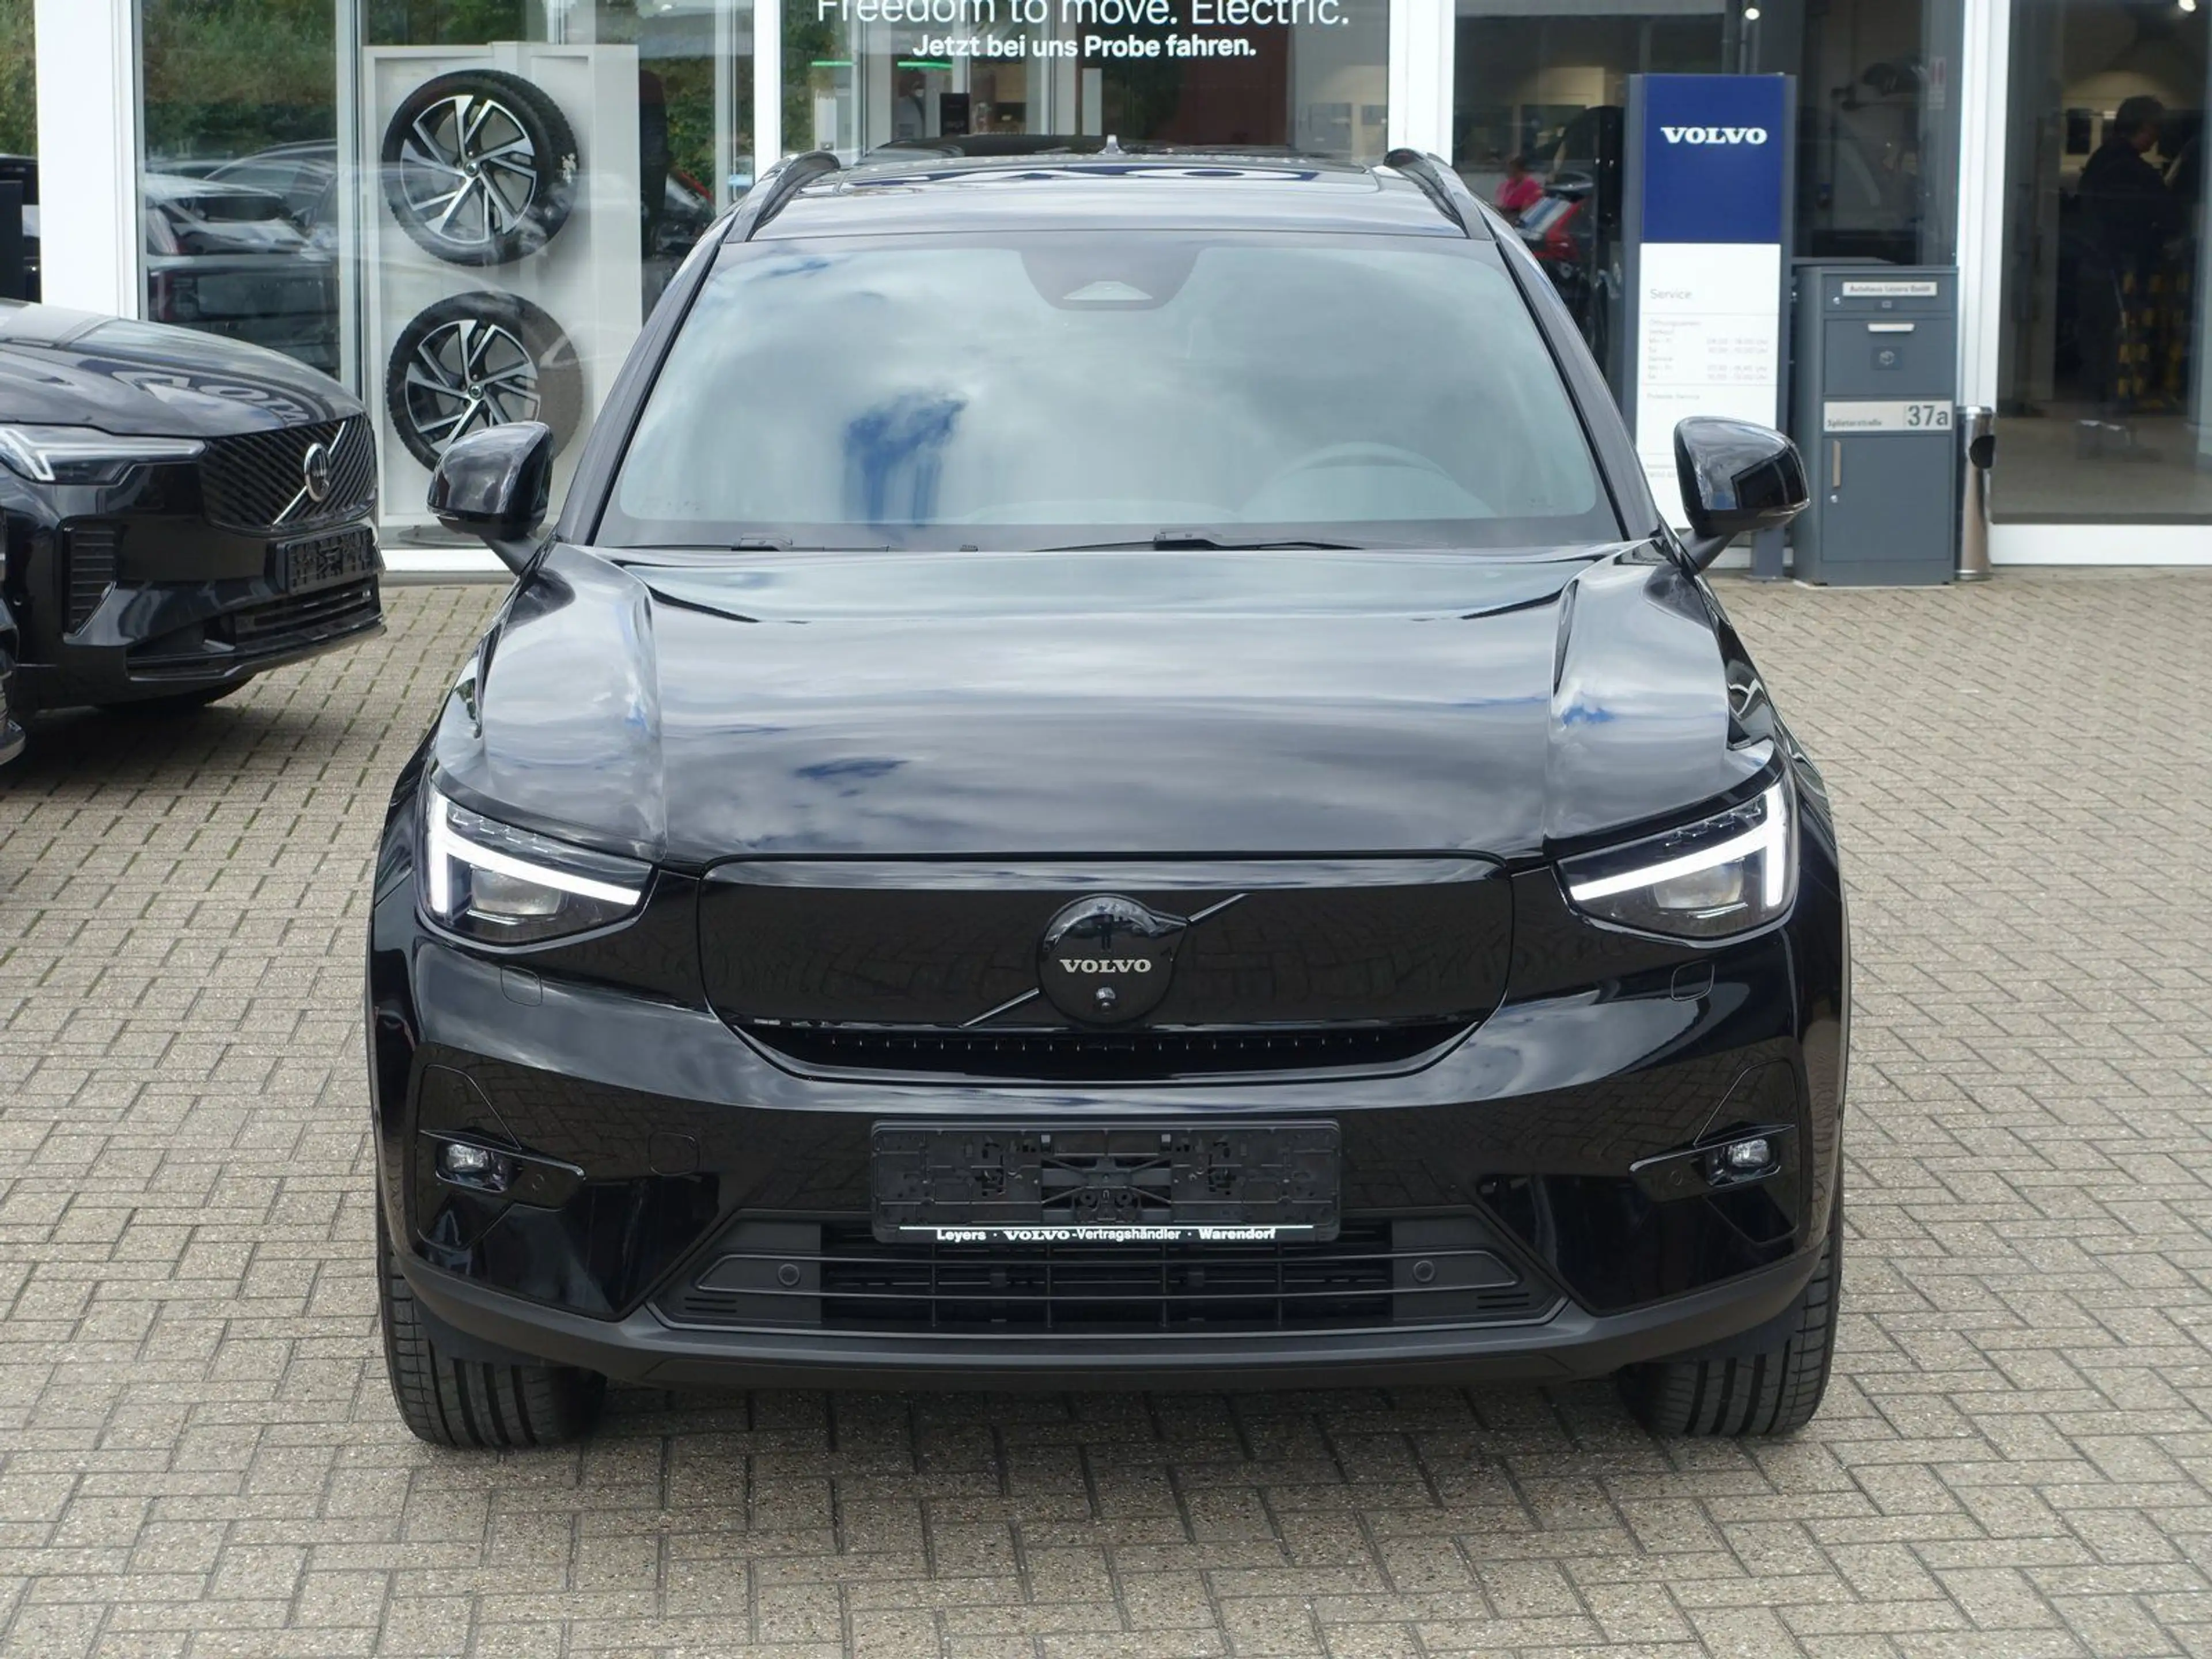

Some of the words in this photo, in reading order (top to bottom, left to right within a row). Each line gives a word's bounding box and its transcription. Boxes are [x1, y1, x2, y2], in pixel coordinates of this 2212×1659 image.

[818, 0, 995, 23] Freedom
[1011, 0, 1048, 24] to
[1062, 0, 1177, 25] move.
[1192, 0, 1350, 25] Electric.
[912, 35, 981, 56] Jetzt
[987, 35, 1025, 56] bei
[1032, 40, 1078, 56] uns
[1085, 35, 1161, 57] Probe
[1165, 33, 1257, 56] fahren.
[1660, 127, 1768, 145] VOLVO
[1650, 287, 1693, 300] Service
[1907, 405, 1948, 427] 37a
[1059, 959, 1152, 973] VOLVO
[937, 1228, 986, 1243] Leyers
[1199, 1228, 1276, 1239] Warendorf
